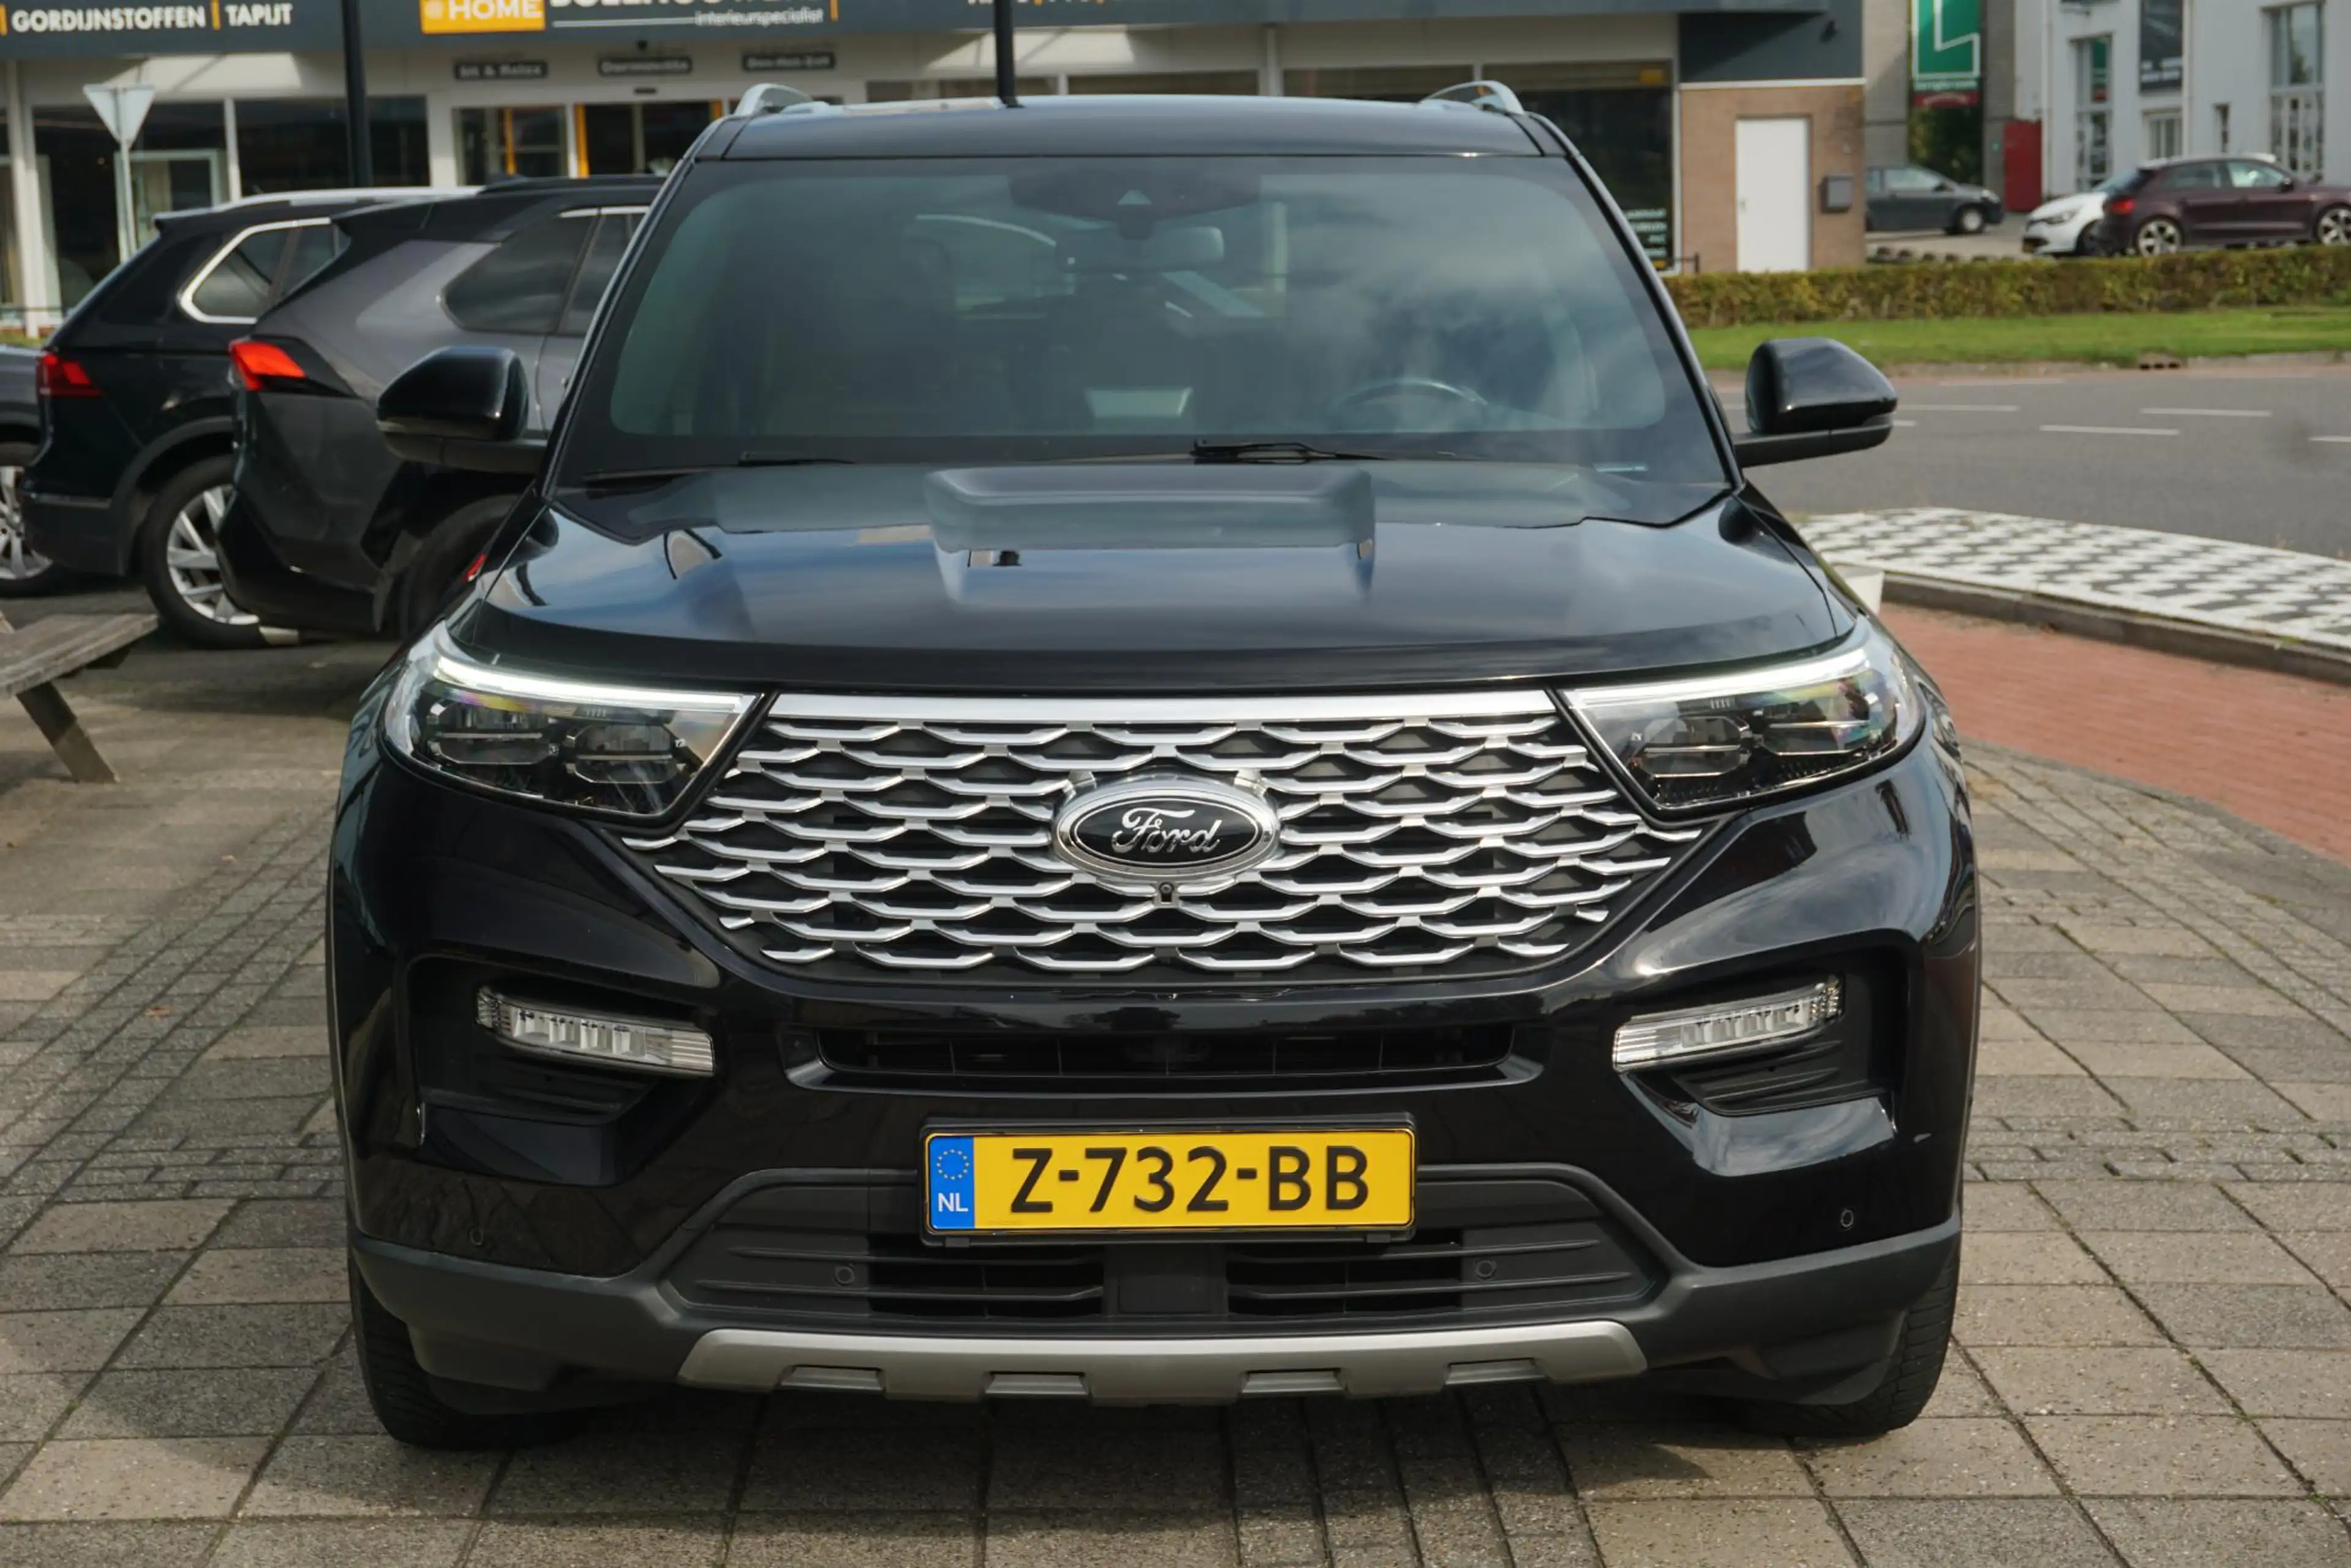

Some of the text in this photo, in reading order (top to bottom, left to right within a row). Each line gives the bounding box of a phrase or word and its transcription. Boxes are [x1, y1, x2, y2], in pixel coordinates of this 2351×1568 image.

[11, 4, 293, 32] GORDIJNSTOFFEN TAPIJT
[448, 0, 542, 20] HOME
[695, 7, 824, 27] interieurspecialist
[1112, 807, 1222, 853] Ford
[1010, 1146, 1370, 1213] Z-732-BB
[938, 1193, 969, 1213] NL
